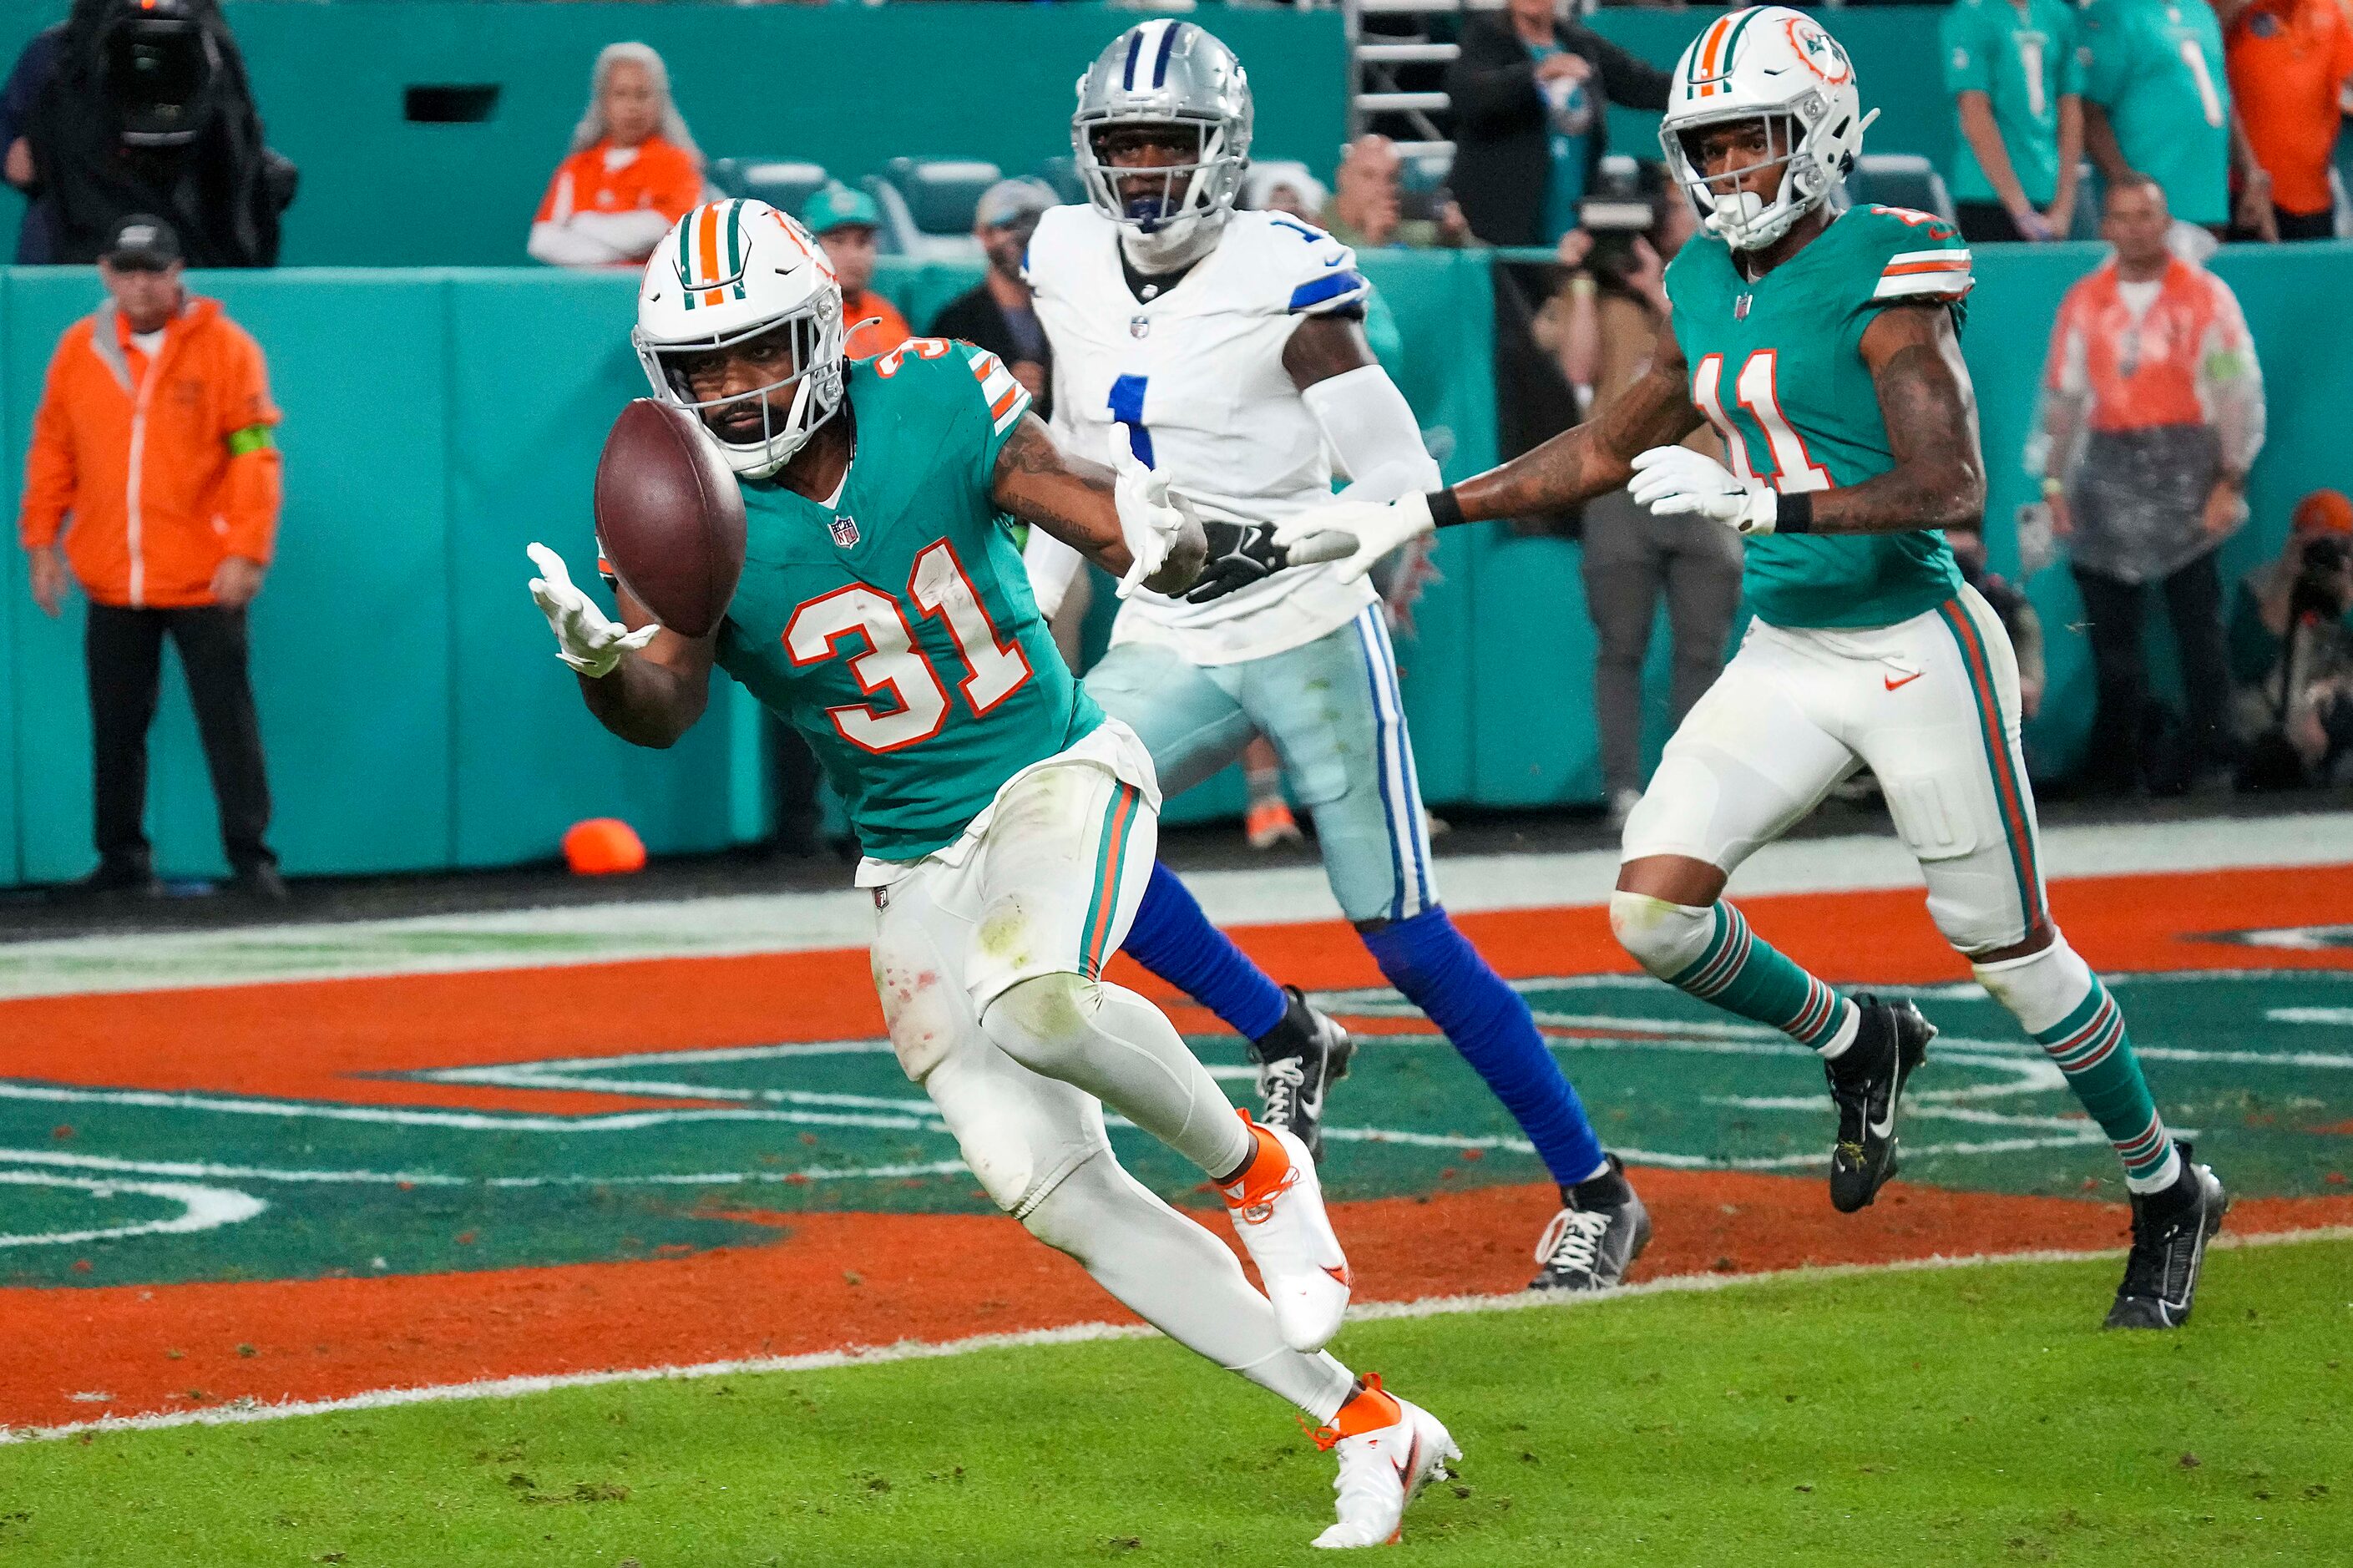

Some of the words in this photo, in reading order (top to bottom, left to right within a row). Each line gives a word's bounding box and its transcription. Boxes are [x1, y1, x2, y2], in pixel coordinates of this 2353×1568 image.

[1107, 373, 1156, 472] 1
[1693, 348, 1835, 494] 11
[781, 535, 1034, 755] 31
